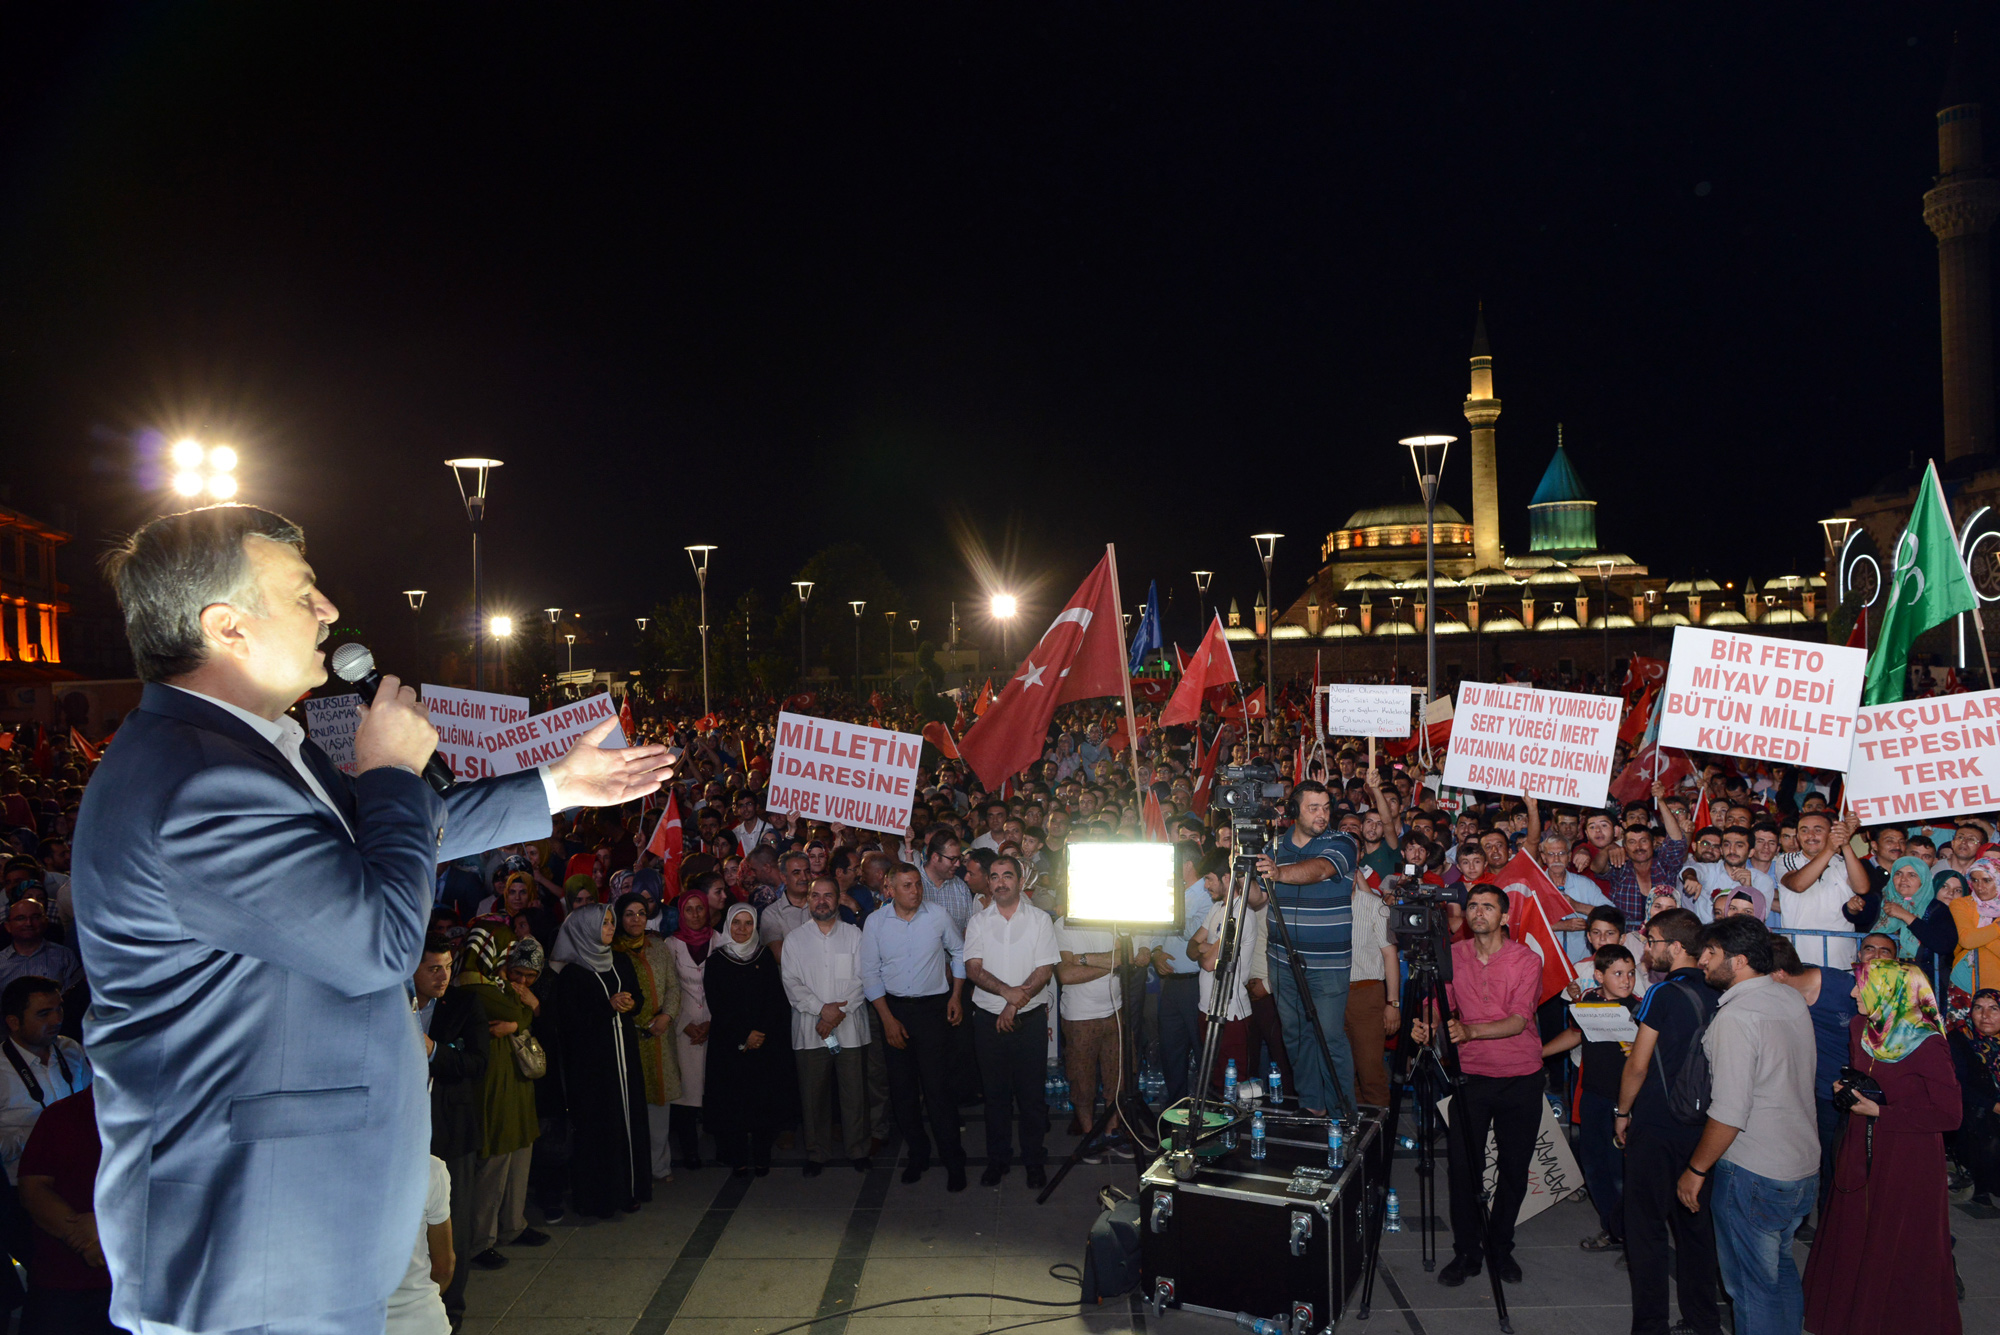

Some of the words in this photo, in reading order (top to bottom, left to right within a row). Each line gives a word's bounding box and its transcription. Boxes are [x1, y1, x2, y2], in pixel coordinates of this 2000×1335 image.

[1711, 636, 1752, 664] BİR
[1760, 645, 1823, 672] FETO
[1692, 664, 1769, 696] MİYAV
[1775, 678, 1834, 705] DEDİ
[423, 696, 485, 720] VARLIĞIM
[490, 704, 527, 724] TÜRK
[1463, 687, 1481, 705] BU
[1483, 686, 1544, 713] MİLLETİN
[1549, 697, 1617, 722] YUMRUĞU
[1667, 691, 1752, 724] BÜTÜN
[1760, 704, 1852, 737] MİLLET
[432, 724, 474, 747] RLIĞINA
[484, 721, 540, 753] DARBE
[541, 698, 613, 734] YAPMAK
[1471, 713, 1504, 733] SERT
[1509, 715, 1558, 741] YÜREĞİ
[1560, 724, 1599, 746] MERT
[779, 720, 919, 769] MİLLETİN
[1454, 736, 1515, 762] VATANINA
[1520, 743, 1548, 766] GÖZ
[1551, 746, 1608, 775] DİKENİN
[1697, 726, 1809, 763] KÜKREDİ
[777, 752, 910, 797] İDARESİNE
[1468, 764, 1515, 789] BAŞINA
[1520, 772, 1580, 798] DERTTİR.
[1894, 757, 1983, 785] TERK
[770, 785, 820, 814] DARBE
[825, 795, 908, 830] VURULMAZ
[1852, 784, 2000, 819] ETMEYEL
